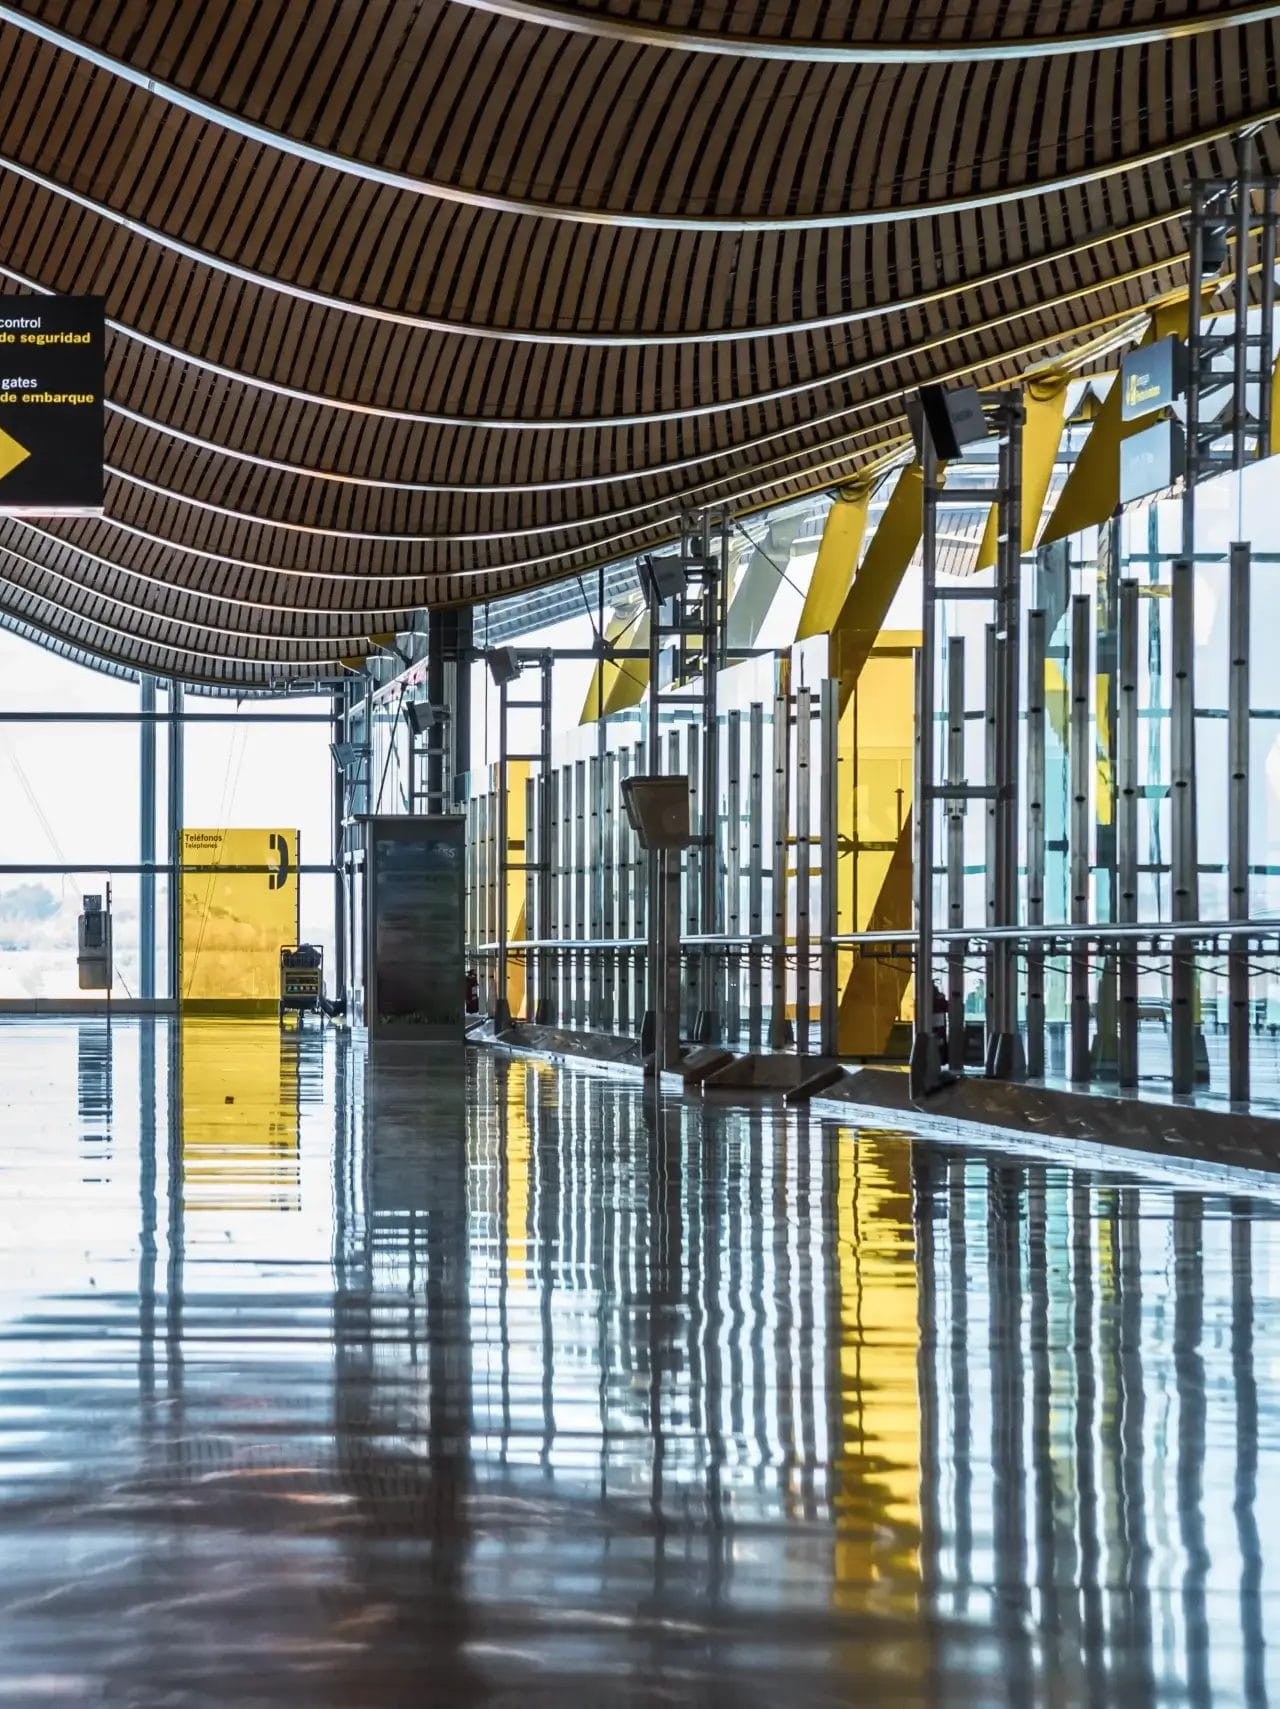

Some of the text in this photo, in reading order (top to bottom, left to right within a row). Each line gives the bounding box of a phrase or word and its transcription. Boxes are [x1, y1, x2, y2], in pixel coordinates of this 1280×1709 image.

[20, 332, 91, 345] seguridad
[1, 377, 38, 390] gates
[0, 391, 17, 403] de
[22, 391, 95, 405] embarque
[185, 833, 222, 842] Teléfonos
[185, 842, 218, 850] Telephones
